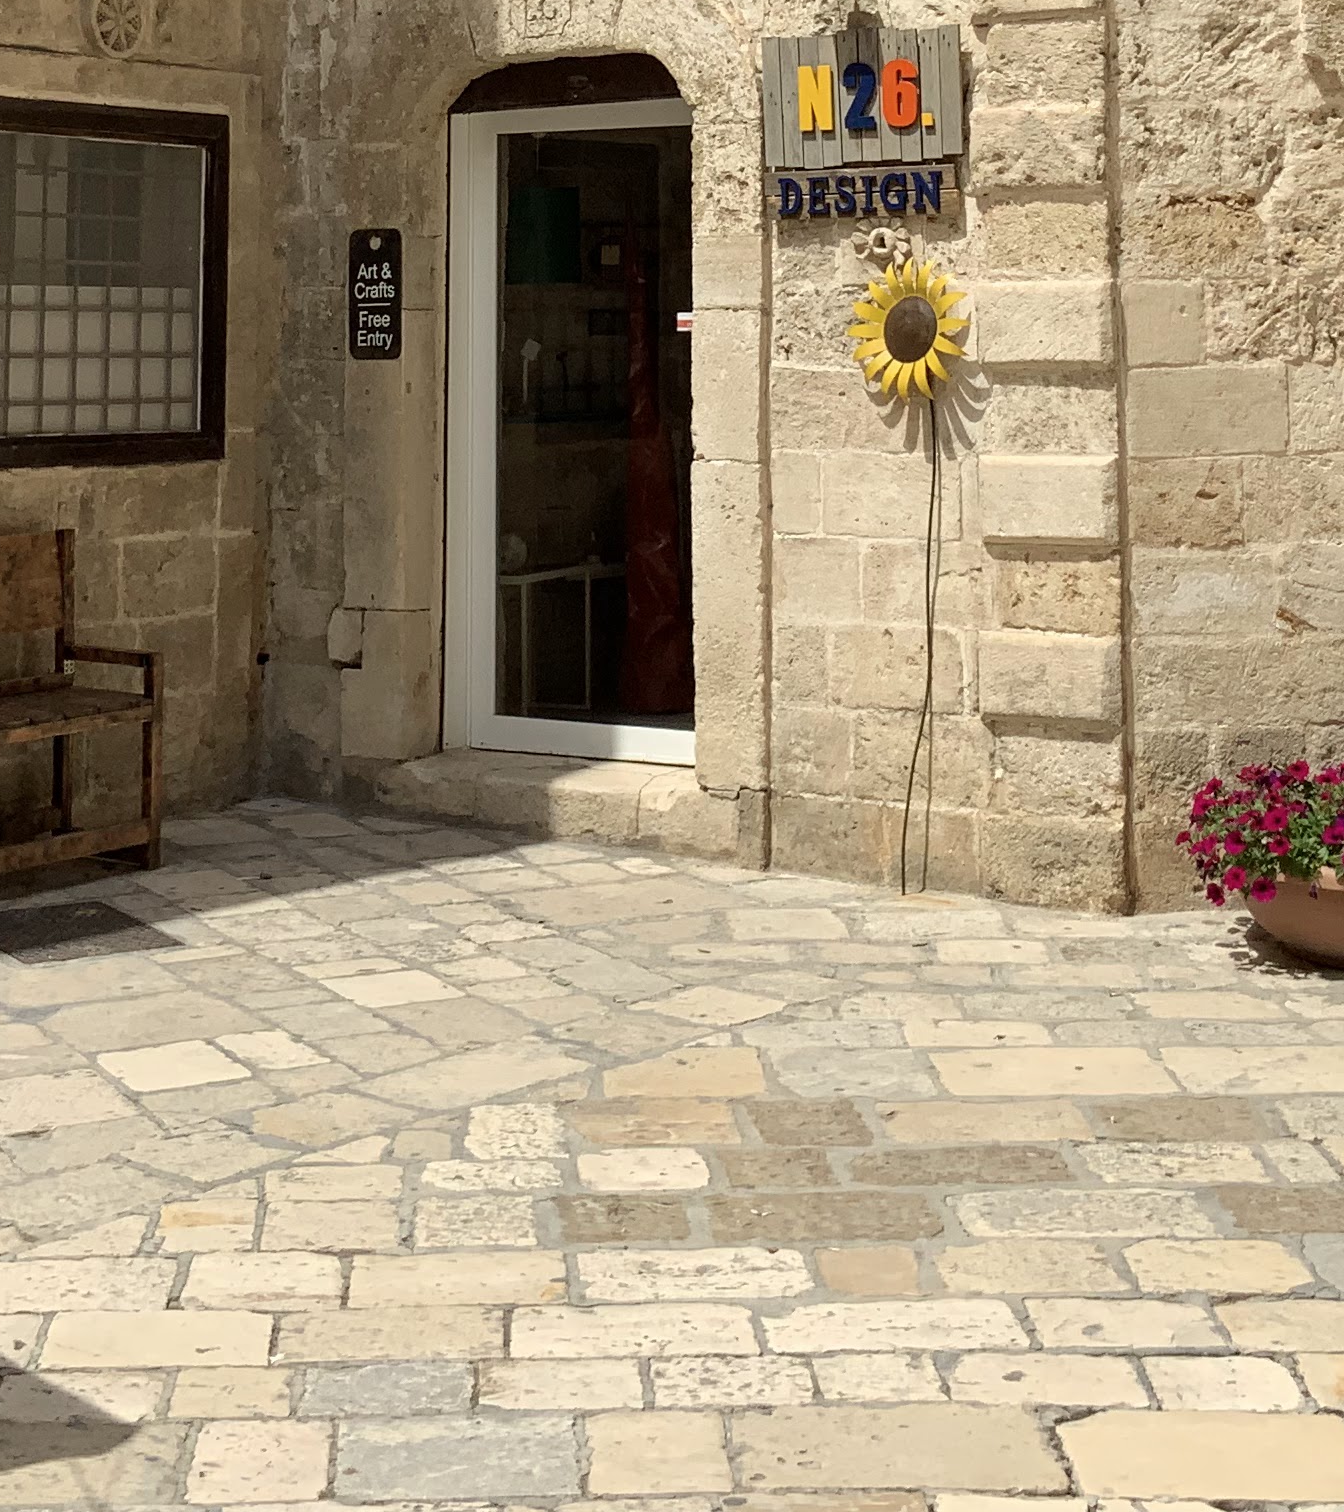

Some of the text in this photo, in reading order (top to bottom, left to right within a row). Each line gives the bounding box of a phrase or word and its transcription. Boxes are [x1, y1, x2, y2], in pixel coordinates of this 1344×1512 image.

[777, 170, 944, 217] DESIGN
[357, 262, 392, 280] Art &
[354, 282, 395, 299] Crafts
[359, 311, 391, 328] Free
[357, 331, 393, 350] Entry
